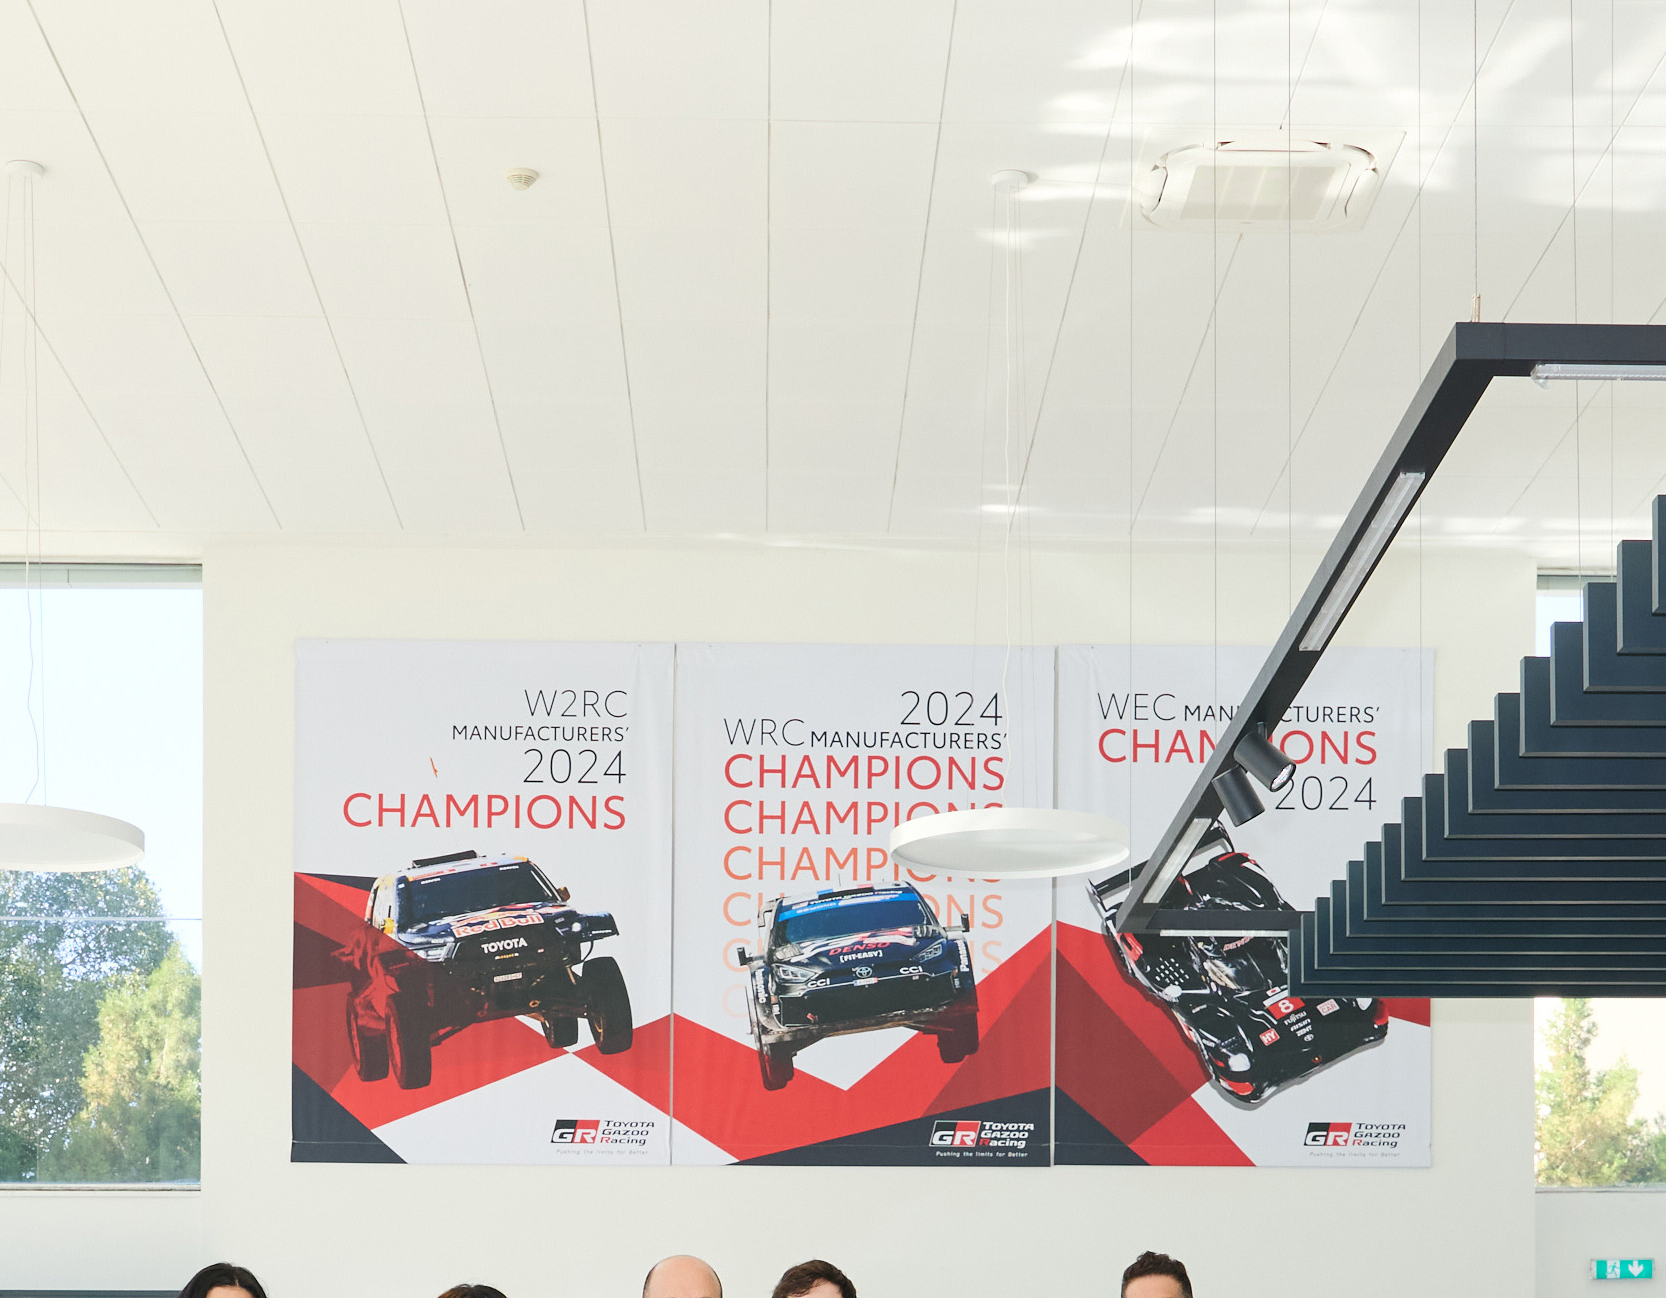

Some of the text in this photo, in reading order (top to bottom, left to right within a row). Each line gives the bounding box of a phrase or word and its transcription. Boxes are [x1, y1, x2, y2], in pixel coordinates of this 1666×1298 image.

[524, 689, 628, 718] W2RC
[900, 690, 1003, 726] 2024
[1097, 693, 1177, 721] WEC
[724, 718, 805, 746] WRC
[523, 748, 626, 784] 2024
[724, 753, 1005, 791] CHAMPIONS
[1275, 776, 1377, 811] 2024
[343, 792, 626, 830] CHAMPIONS
[454, 913, 544, 938] Red Bull
[481, 937, 528, 954] TOYOTA
[829, 941, 891, 956] DENSO
[899, 965, 923, 975] CCI
[807, 977, 830, 989] CCI
[1278, 999, 1294, 1013] 8
[1320, 1003, 1338, 1015] CAR
[1283, 1011, 1307, 1026] FUJITSU
[1262, 1031, 1277, 1044] HY
[604, 1119, 655, 1128] TOYOTA
[982, 1121, 1035, 1131] TOYOTA
[1356, 1122, 1406, 1130] TOYOTA
[552, 1128, 598, 1143] GR
[601, 1128, 649, 1136] GAZOO
[933, 1130, 976, 1146] GR
[980, 1130, 1029, 1139] GAZOO
[1305, 1131, 1349, 1146] GR
[1354, 1131, 1401, 1139] GAZOO
[600, 1136, 647, 1146] Racing
[979, 1138, 1026, 1149] Racing
[1352, 1139, 1398, 1149] Racing
